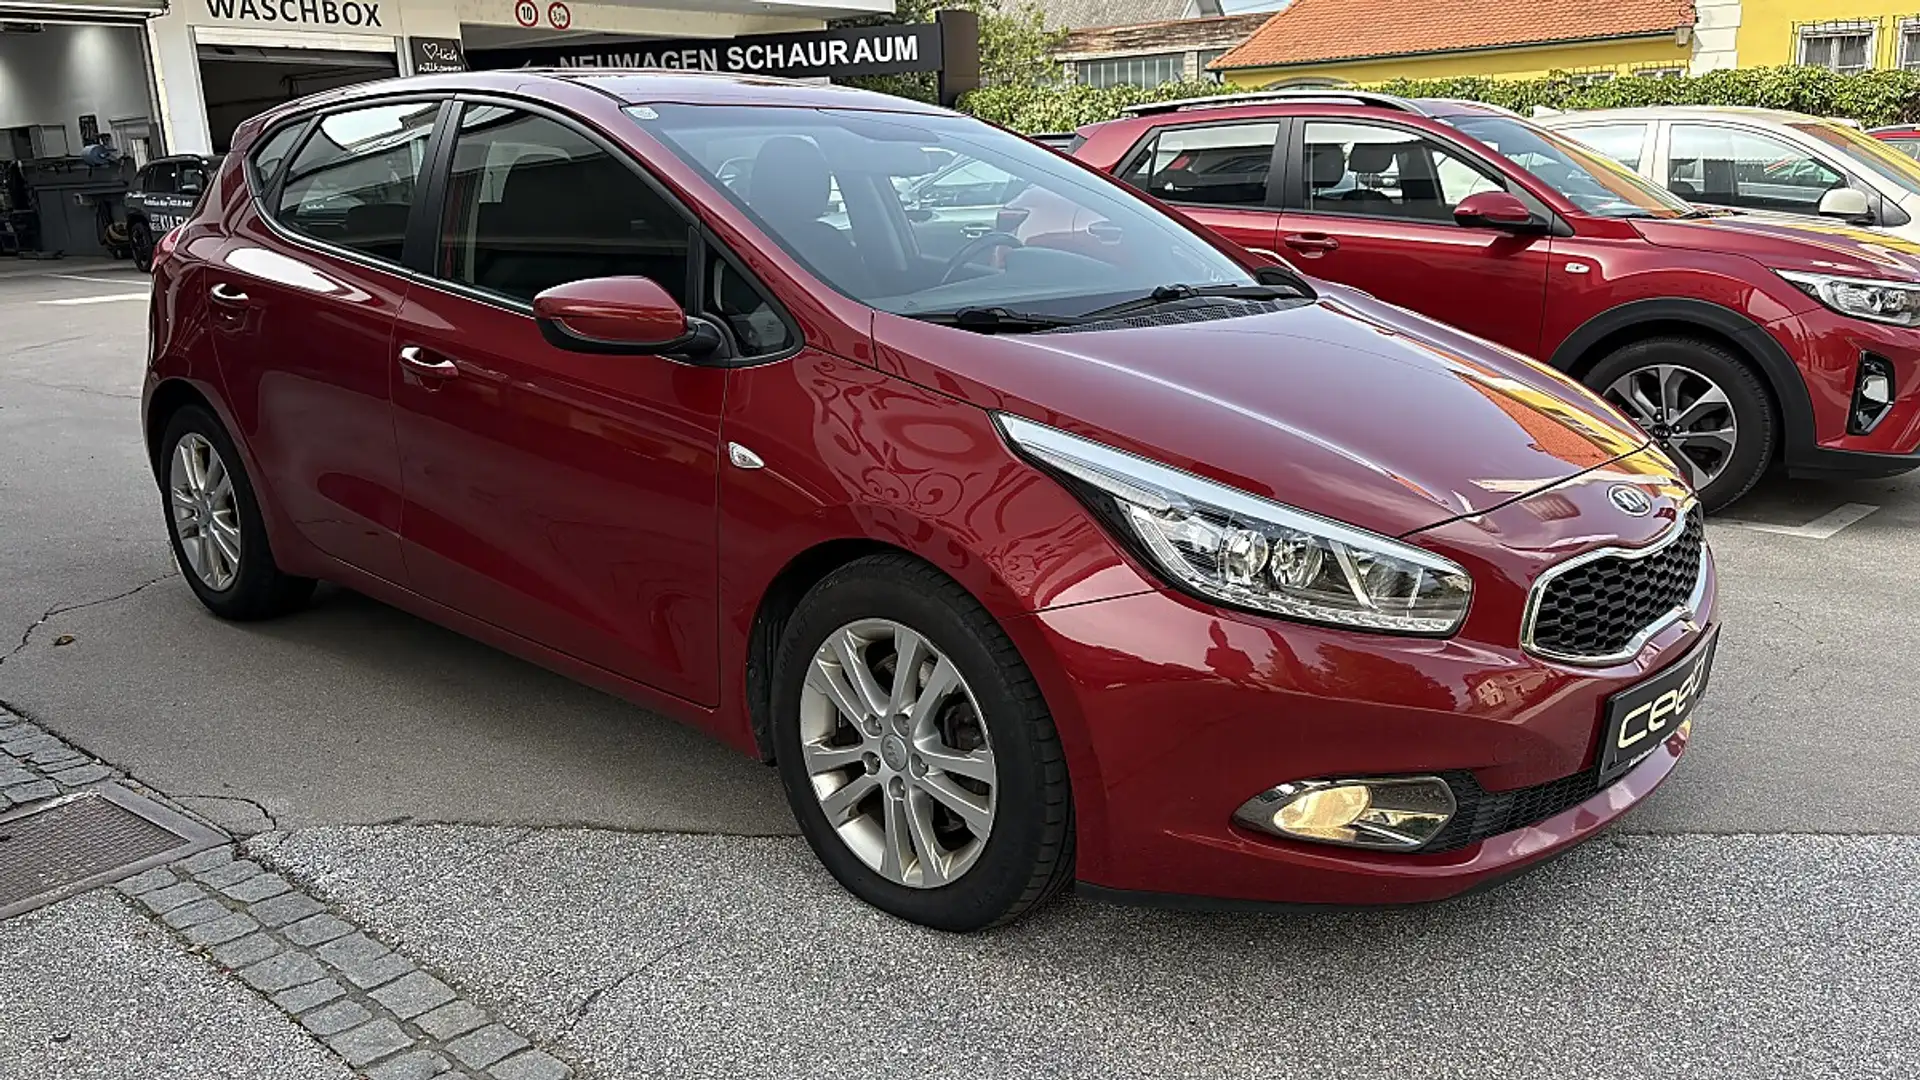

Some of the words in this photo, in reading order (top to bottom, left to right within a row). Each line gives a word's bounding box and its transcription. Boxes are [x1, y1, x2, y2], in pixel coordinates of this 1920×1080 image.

[206, 0, 382, 27] WASCHBOX
[521, 6, 533, 20] 10
[559, 48, 718, 71] NEUWAGEN
